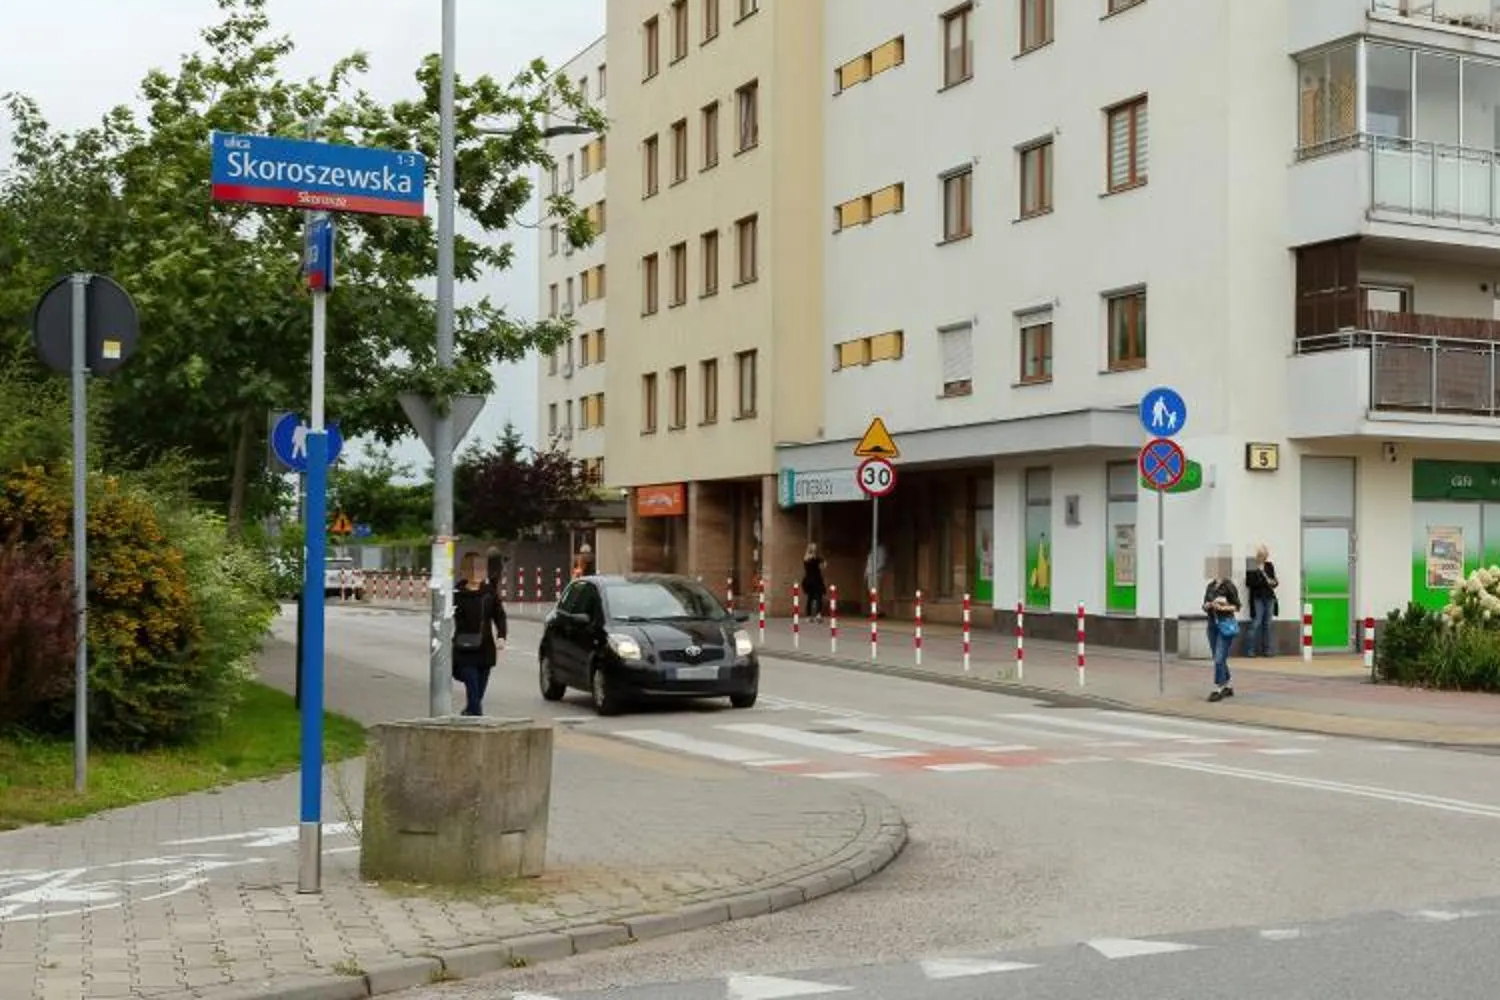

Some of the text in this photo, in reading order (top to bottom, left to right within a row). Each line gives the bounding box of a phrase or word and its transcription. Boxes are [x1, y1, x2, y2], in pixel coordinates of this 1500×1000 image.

[396, 154, 416, 167] 1-3
[226, 151, 412, 193] Skoroszewska
[1259, 451, 1269, 467] 5
[863, 467, 890, 487] 30
